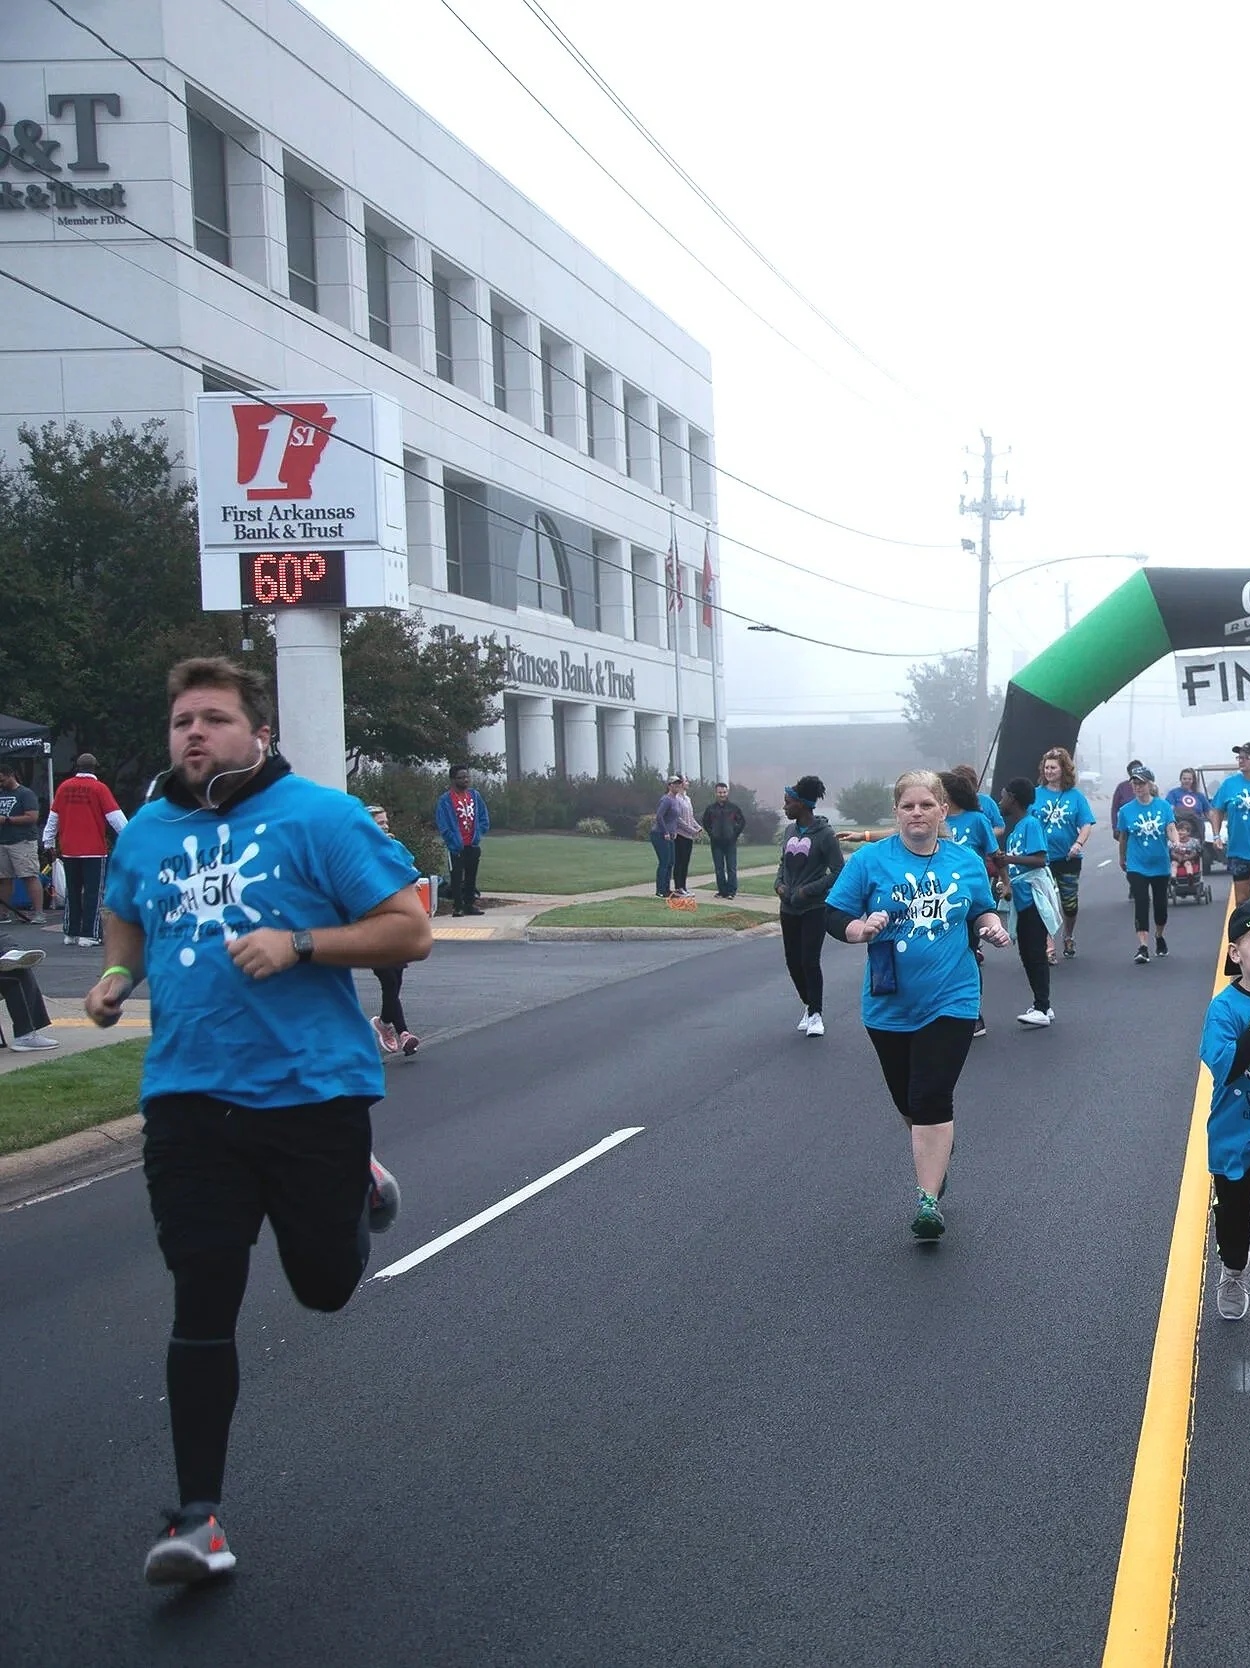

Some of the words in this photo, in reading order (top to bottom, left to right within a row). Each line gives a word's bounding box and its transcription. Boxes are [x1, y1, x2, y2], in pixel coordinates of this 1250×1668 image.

[0, 93, 121, 172] &T
[25, 184, 50, 209] &
[57, 216, 98, 226] Member
[221, 505, 263, 522] First
[267, 504, 355, 521] Arkansas
[234, 522, 280, 540] Bank
[283, 525, 297, 539] &
[298, 522, 344, 538] Trust
[487, 629, 559, 688] kansas
[560, 651, 594, 694] Bank
[605, 660, 636, 700] Trust
[159, 839, 234, 885] SPLASH
[202, 872, 237, 908] 5K
[891, 878, 943, 902] SPLASH
[921, 898, 946, 919] 5K
